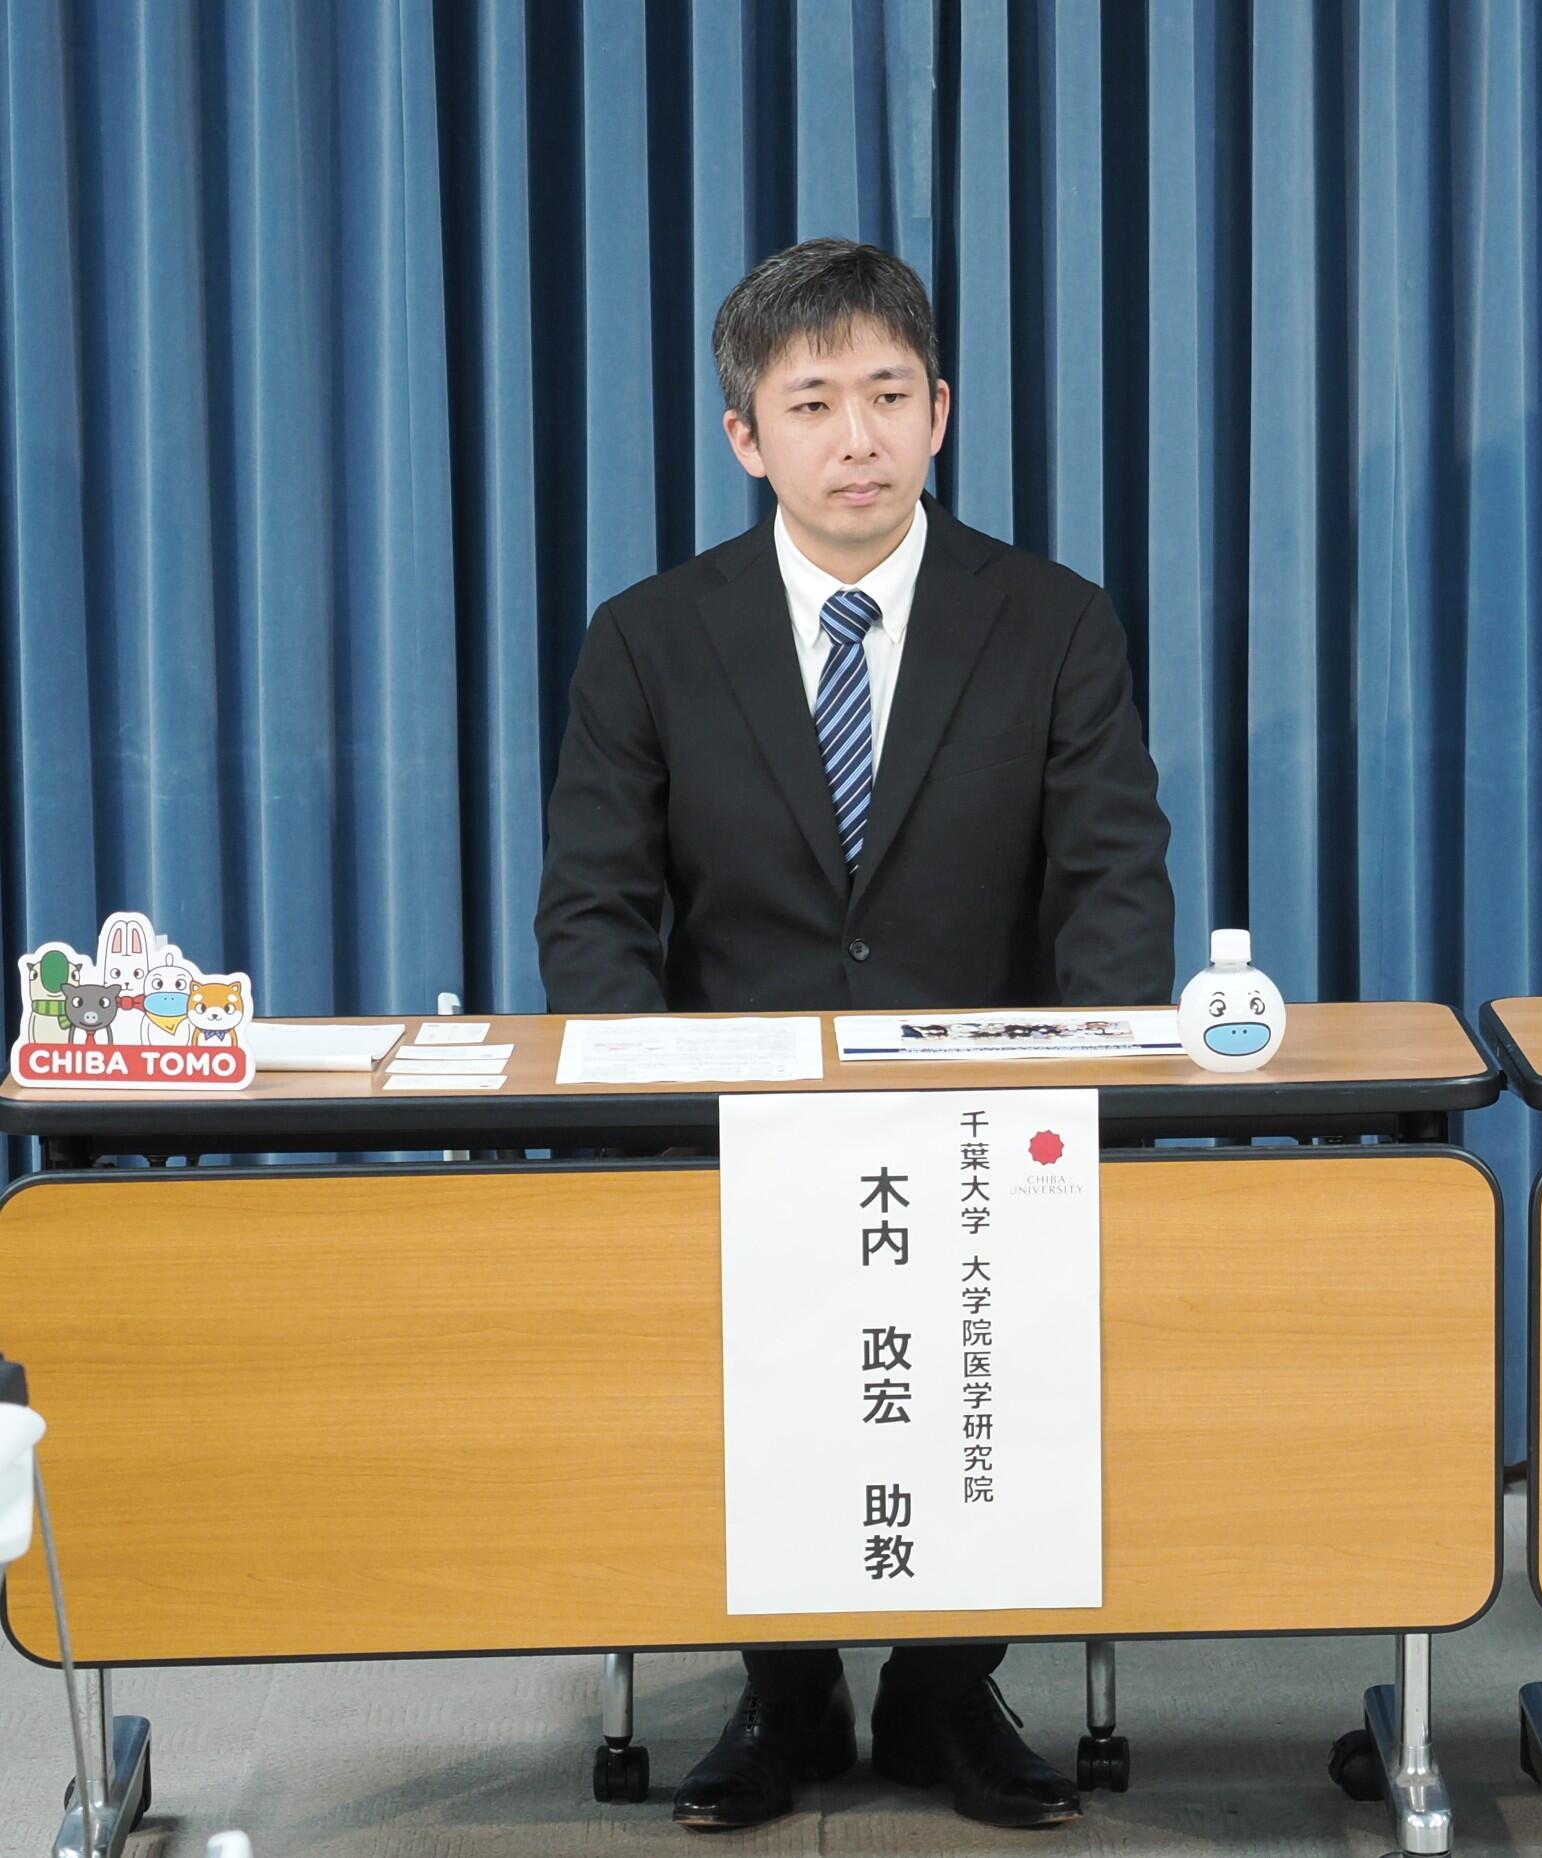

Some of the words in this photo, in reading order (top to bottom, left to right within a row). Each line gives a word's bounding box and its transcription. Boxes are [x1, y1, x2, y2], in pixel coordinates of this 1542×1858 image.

[28, 1049, 129, 1075] CHIBA
[140, 1051, 237, 1077] TOMO
[859, 1166, 911, 1267] 木内
[960, 1110, 991, 1235] 千葉大学
[1009, 1185, 1084, 1195] UNIVERSITY
[1026, 1175, 1067, 1185] CHIBA
[862, 1325, 913, 1424] 政宏
[961, 1255, 994, 1503] 大学院医学研究院
[863, 1483, 915, 1580] 助教
